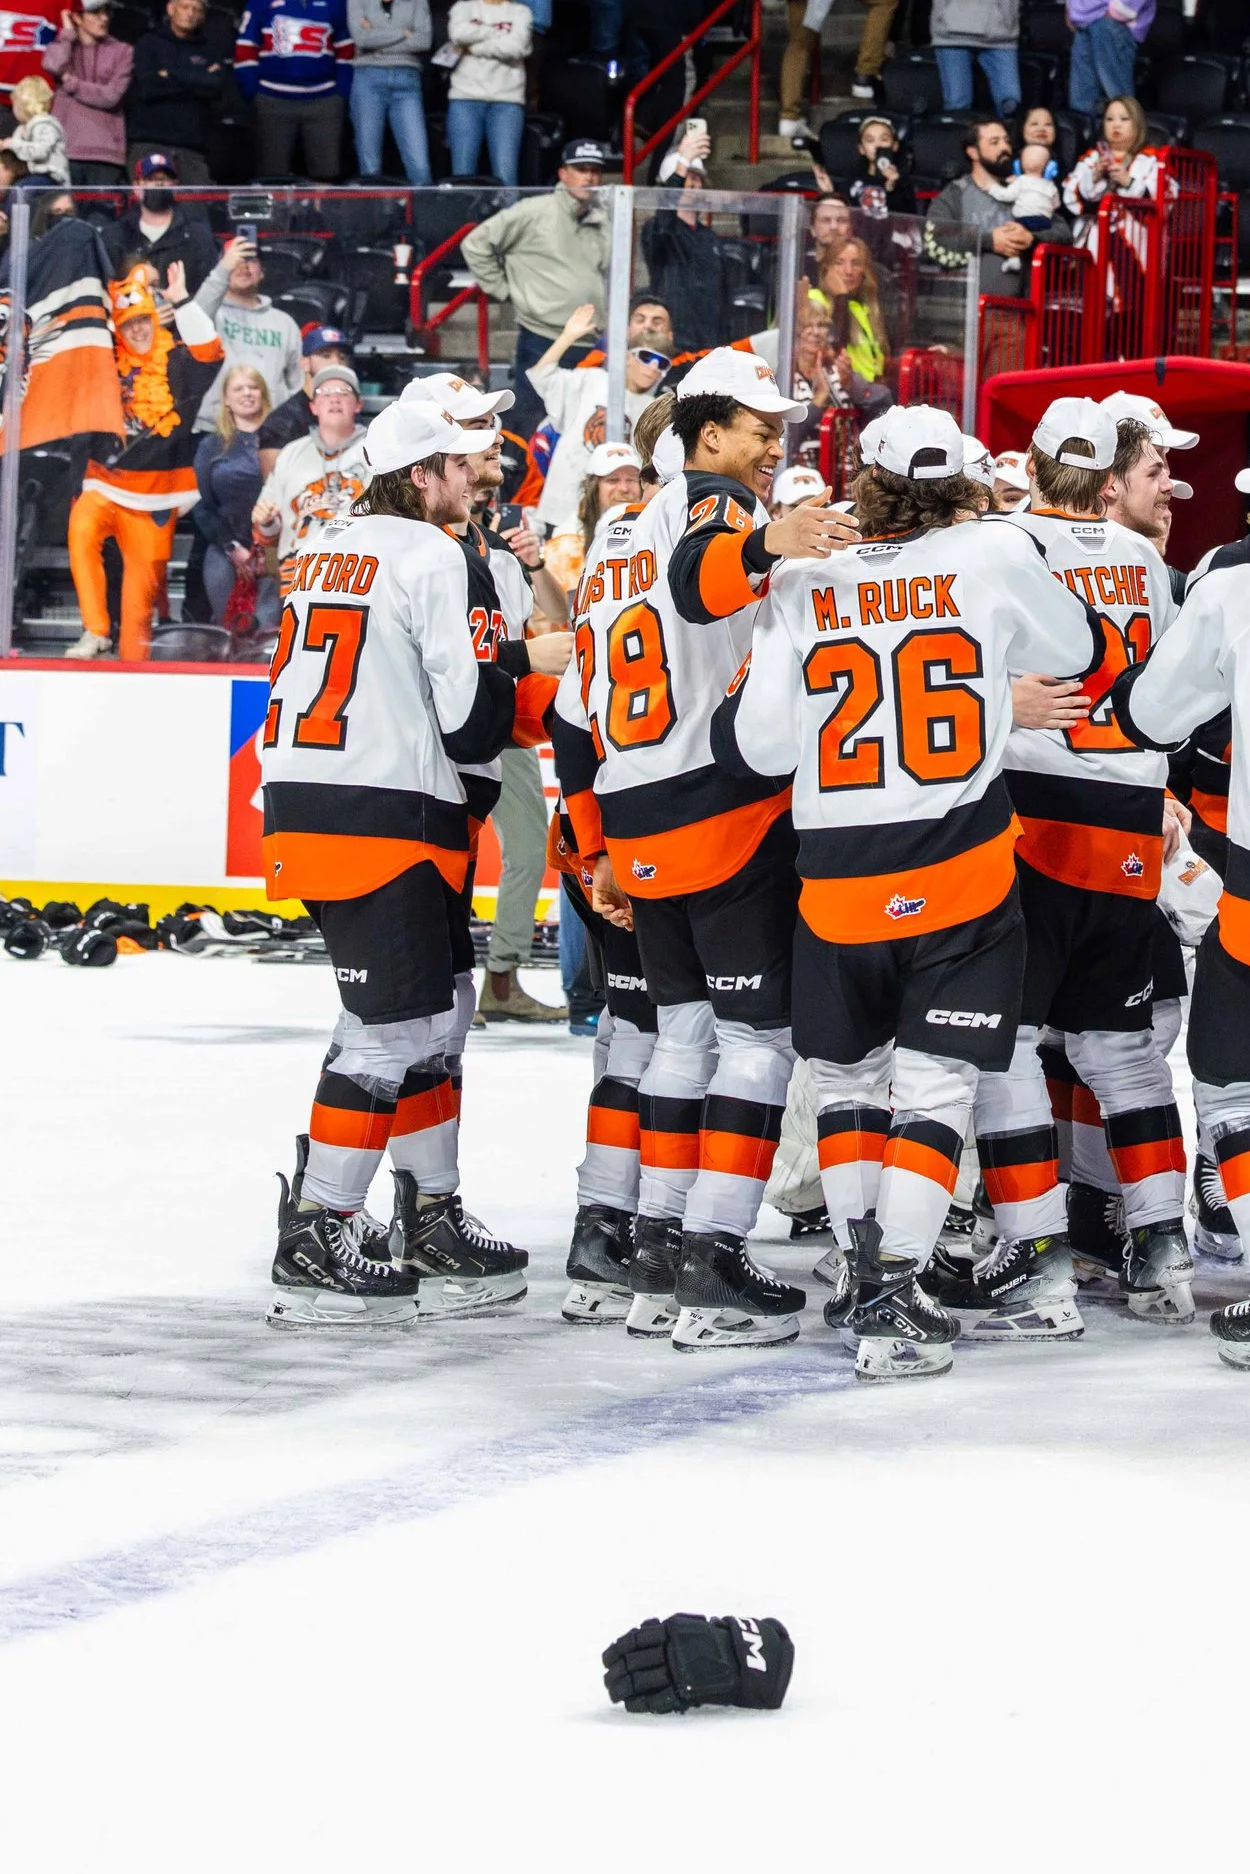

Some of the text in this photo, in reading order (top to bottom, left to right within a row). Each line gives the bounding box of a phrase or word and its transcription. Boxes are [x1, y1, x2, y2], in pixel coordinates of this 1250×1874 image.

[1071, 526, 1106, 535] CCM
[857, 544, 905, 555] CCM
[573, 549, 659, 617] STRO
[812, 573, 963, 633] M. RUCK
[804, 626, 987, 793] 26
[334, 967, 369, 984] CM
[607, 972, 648, 992] CCM
[706, 974, 763, 992] CCM
[1124, 975, 1154, 1008] CC
[926, 1008, 1002, 1029] CCM
[667, 1227, 686, 1238] TRU
[423, 1243, 463, 1270] CCM
[293, 1251, 346, 1291] CCM
[894, 1316, 918, 1338] CM
[737, 1615, 768, 1674] CM
